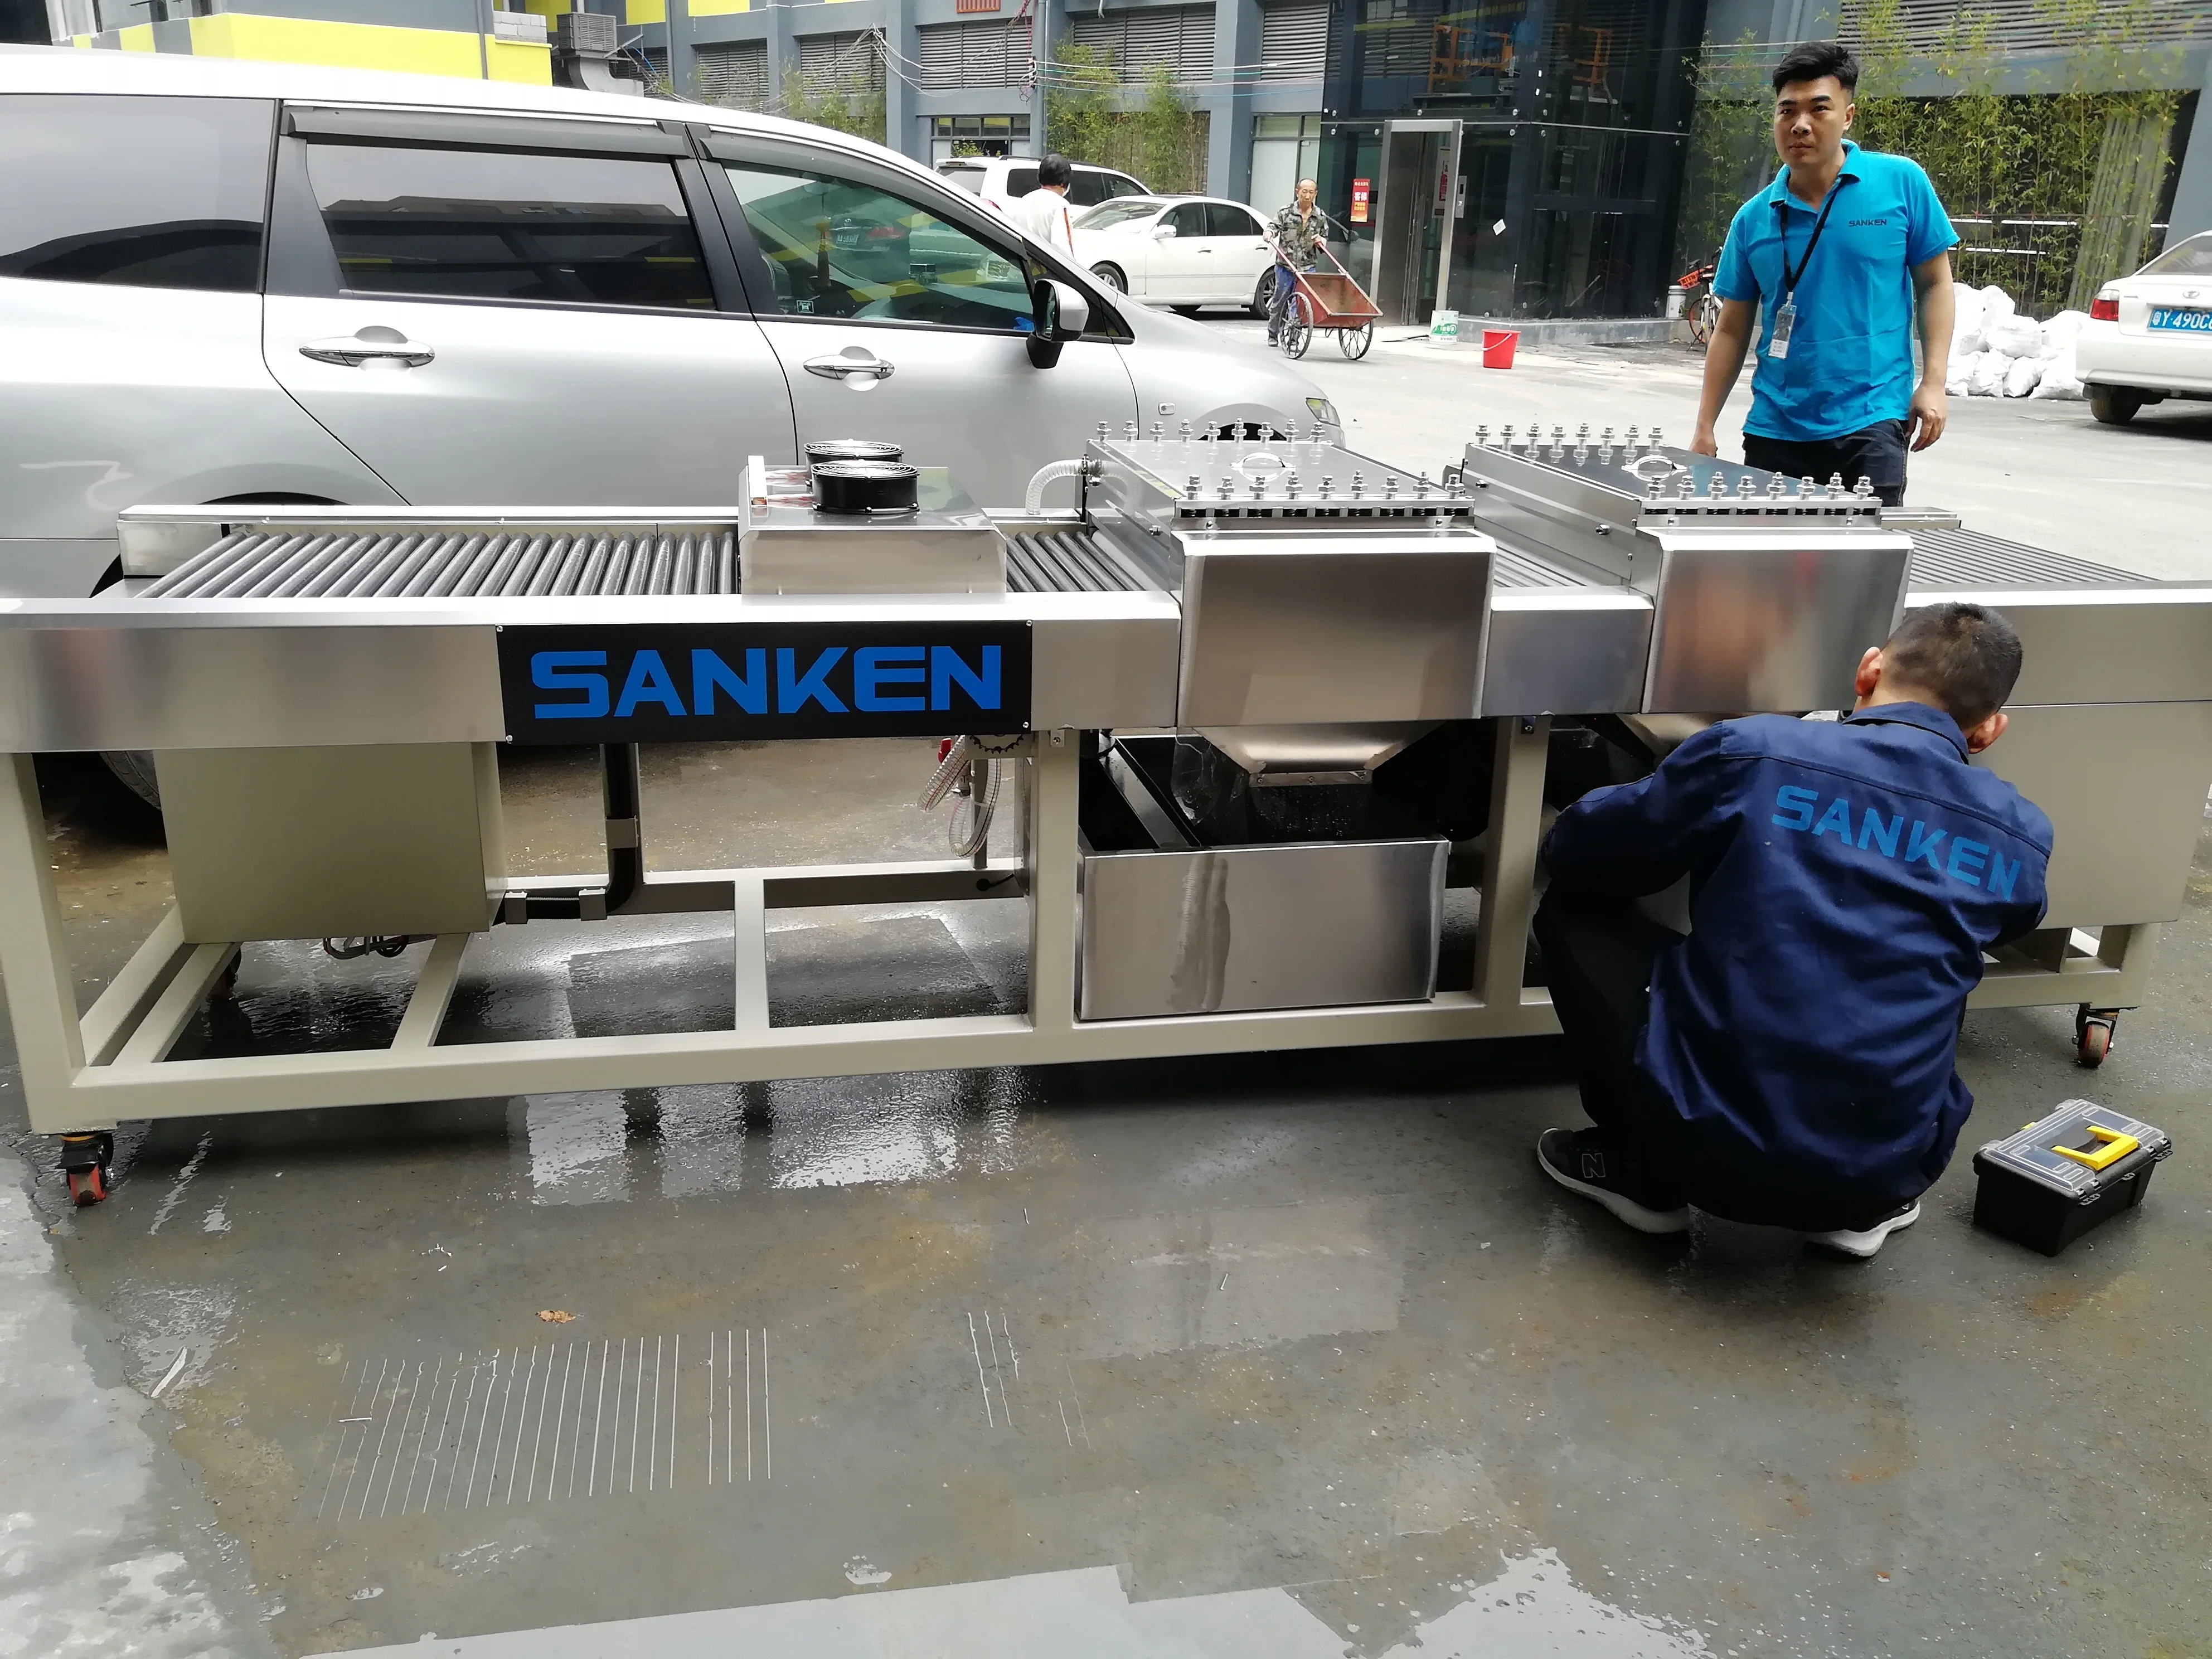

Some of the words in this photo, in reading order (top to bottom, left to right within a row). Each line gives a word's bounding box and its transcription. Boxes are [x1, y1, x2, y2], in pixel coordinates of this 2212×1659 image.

[1848, 219, 1888, 227] SANKEN
[531, 644, 1002, 719] SANKEN
[1771, 784, 2021, 901] SANKEN
[1582, 1152, 1606, 1178] N
